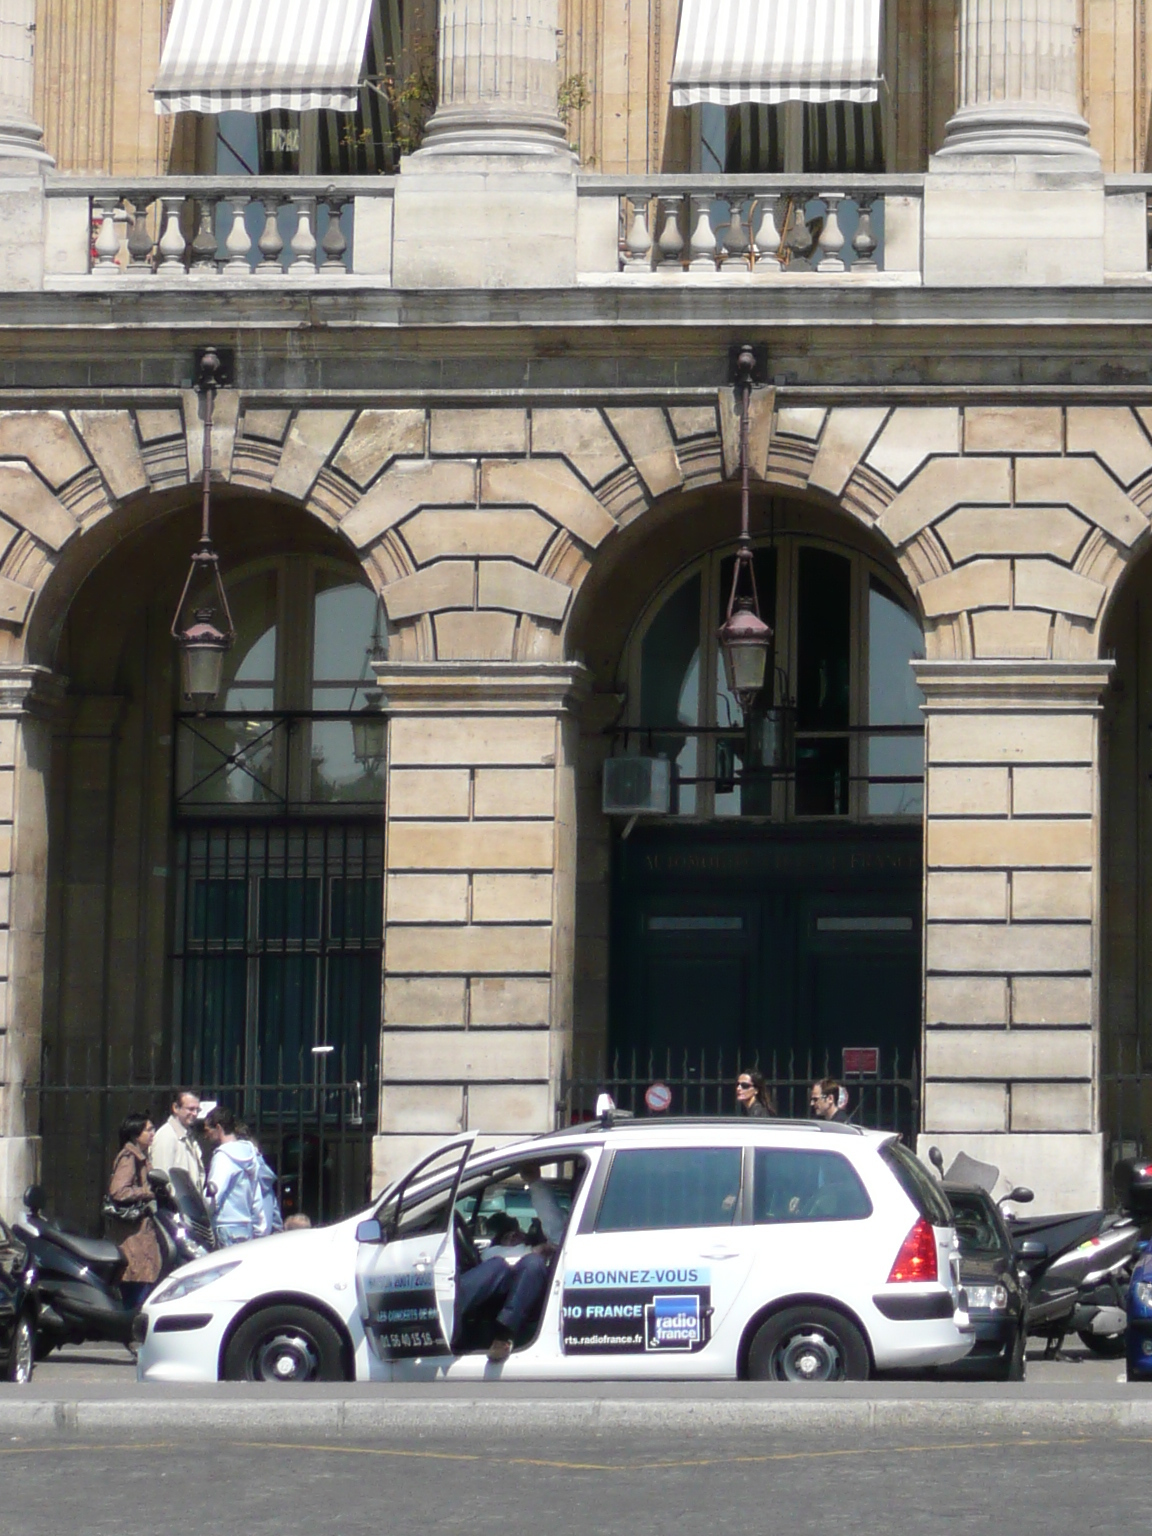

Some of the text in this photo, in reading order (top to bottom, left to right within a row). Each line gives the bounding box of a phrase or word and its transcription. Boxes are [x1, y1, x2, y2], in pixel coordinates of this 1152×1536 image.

[572, 1269, 698, 1285] ABONNEZ-VOUS
[586, 1305, 643, 1318] FRANCE
[656, 1312, 696, 1328] radio
[564, 1334, 643, 1345] rts.radiofrance.fr
[656, 1328, 696, 1340] france
